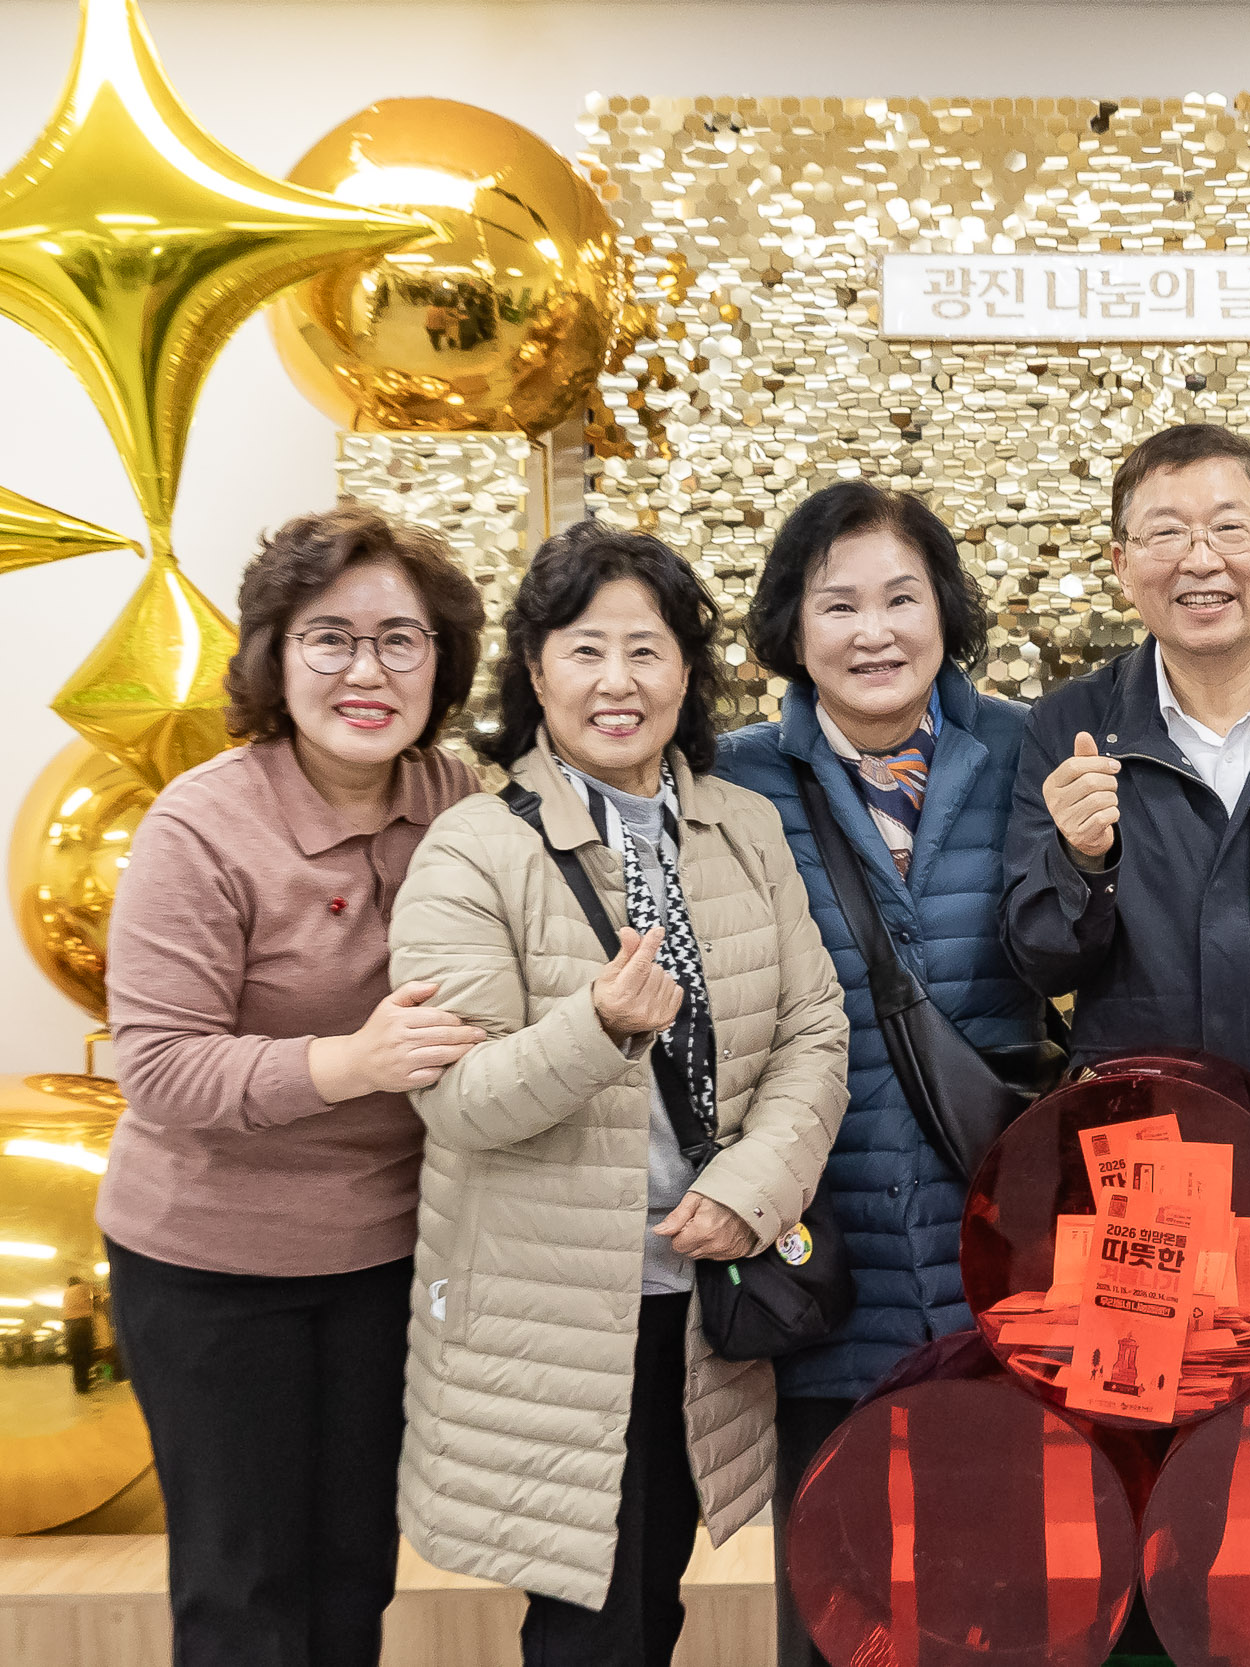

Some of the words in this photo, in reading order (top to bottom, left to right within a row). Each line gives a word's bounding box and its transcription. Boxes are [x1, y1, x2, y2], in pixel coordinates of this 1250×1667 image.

[922, 266, 1025, 320] 광진
[1044, 266, 1196, 320] 나눔의
[1098, 1159, 1126, 1173] 2026
[1106, 1224, 1137, 1239] 2026
[1101, 1238, 1185, 1273] 따뜻한
